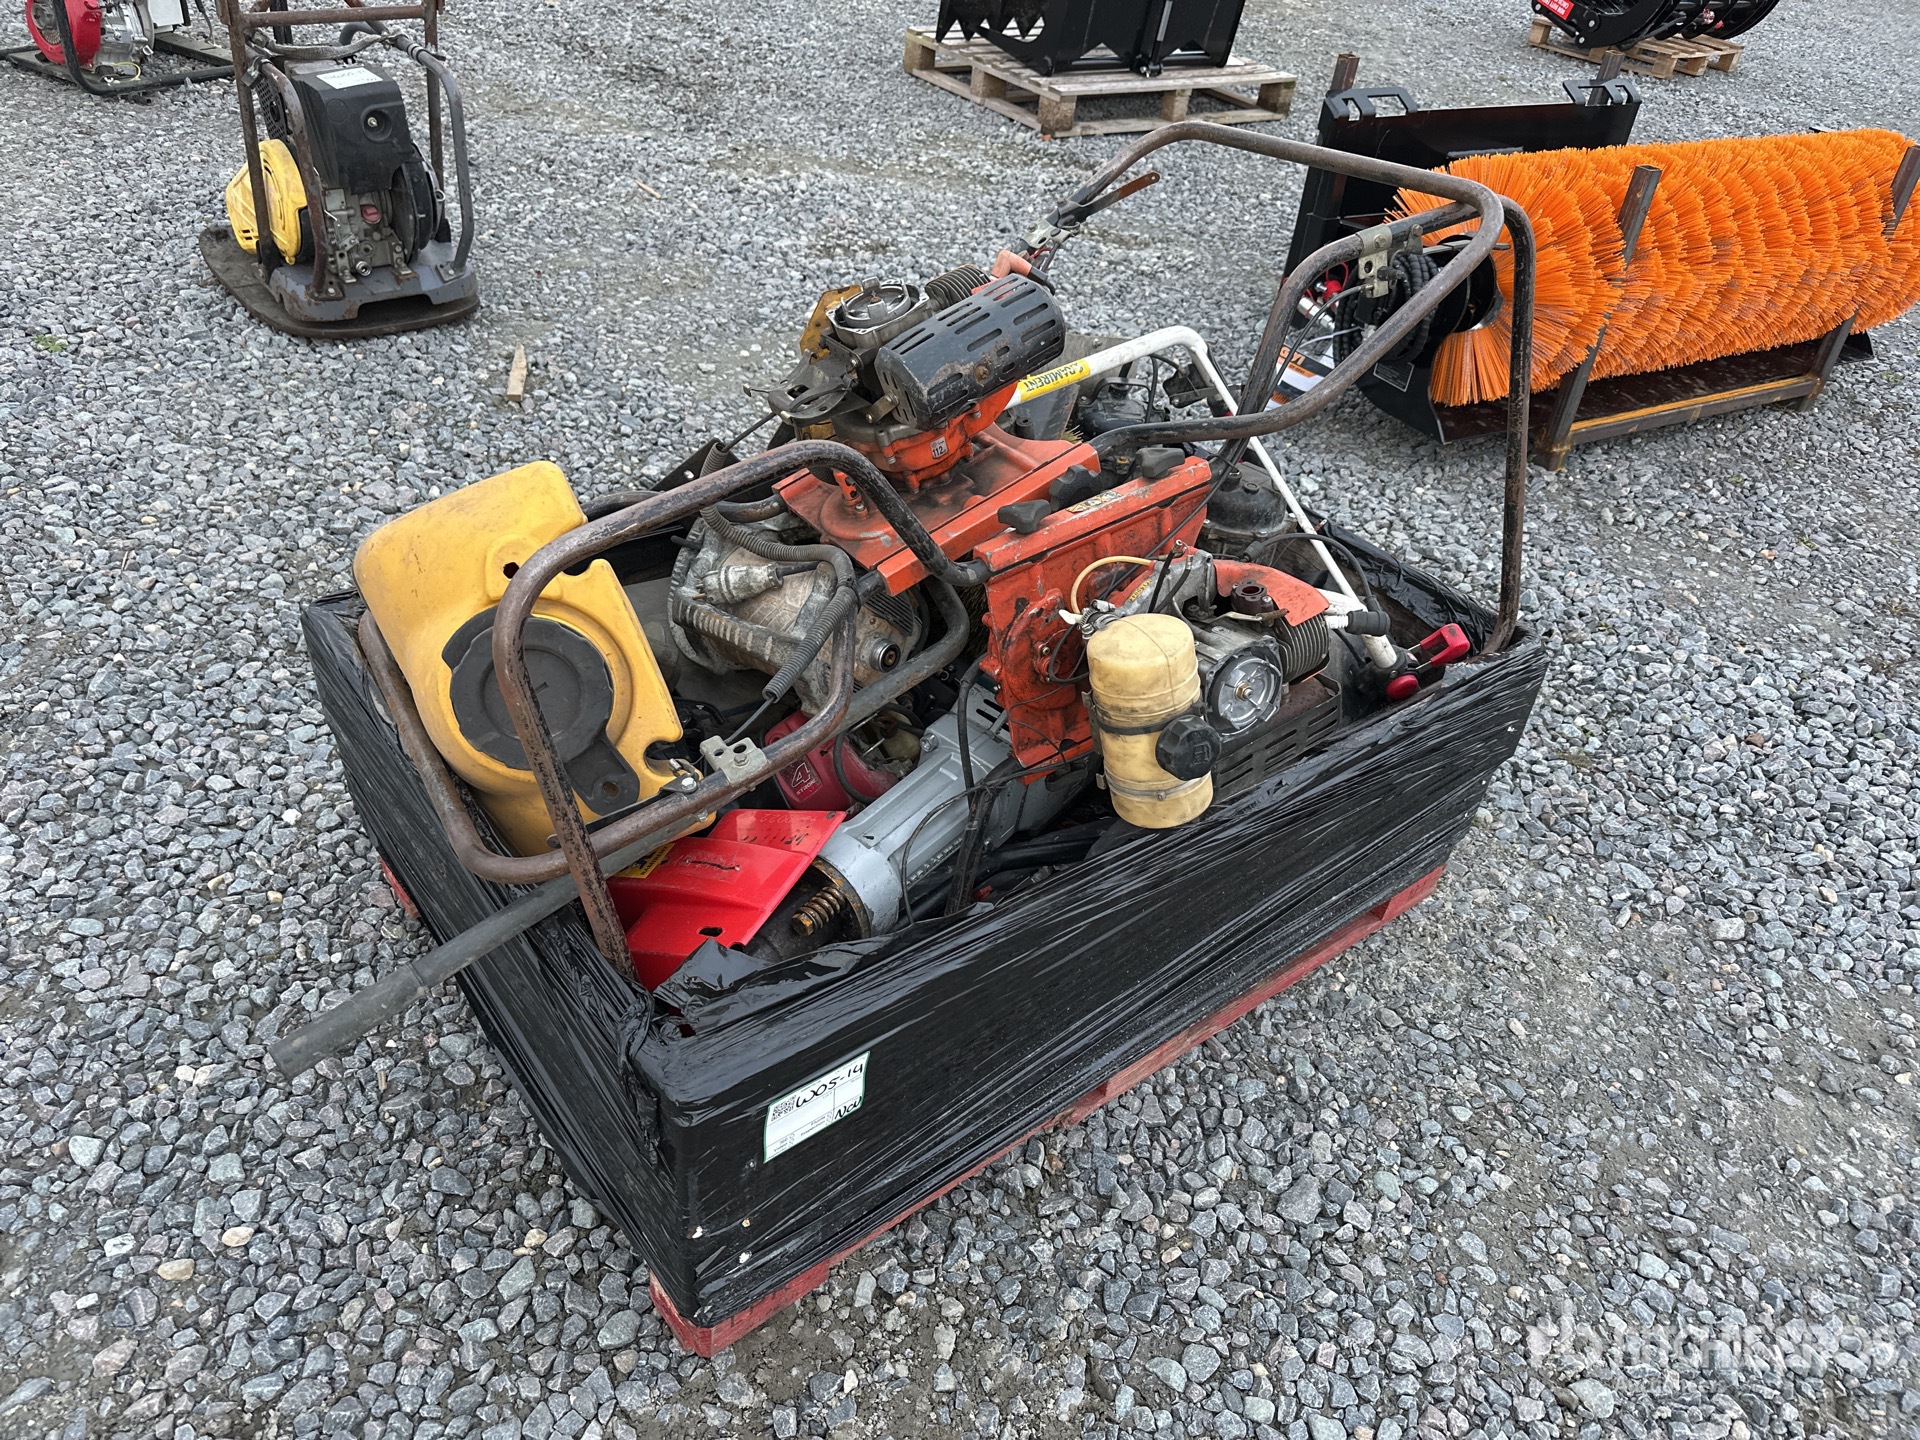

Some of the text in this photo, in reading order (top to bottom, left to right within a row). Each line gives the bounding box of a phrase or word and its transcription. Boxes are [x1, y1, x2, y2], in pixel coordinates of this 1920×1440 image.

[932, 445, 944, 457] 112
[791, 762, 811, 788] 4
[640, 846, 669, 876] RAMIRENT
